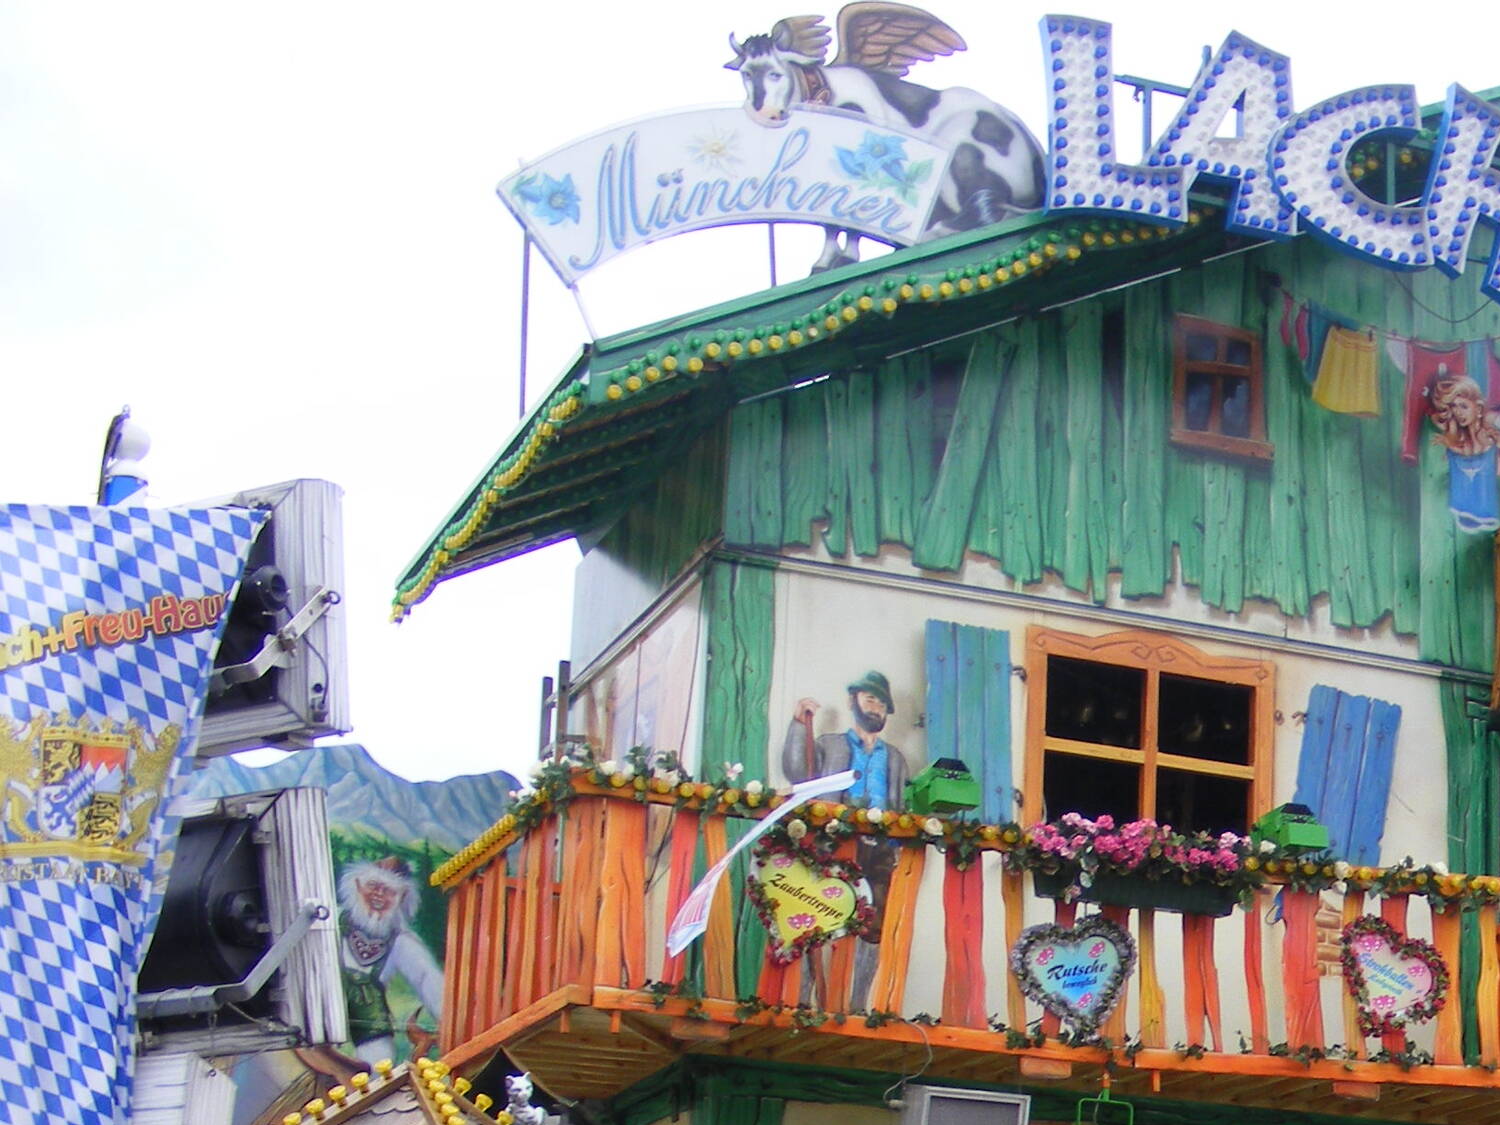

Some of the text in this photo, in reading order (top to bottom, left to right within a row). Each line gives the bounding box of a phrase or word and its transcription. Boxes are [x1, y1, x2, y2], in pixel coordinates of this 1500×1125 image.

[567, 126, 914, 272] Münchner
[769, 872, 844, 920] Zaubertreppe
[1047, 959, 1108, 980] Rutsche
